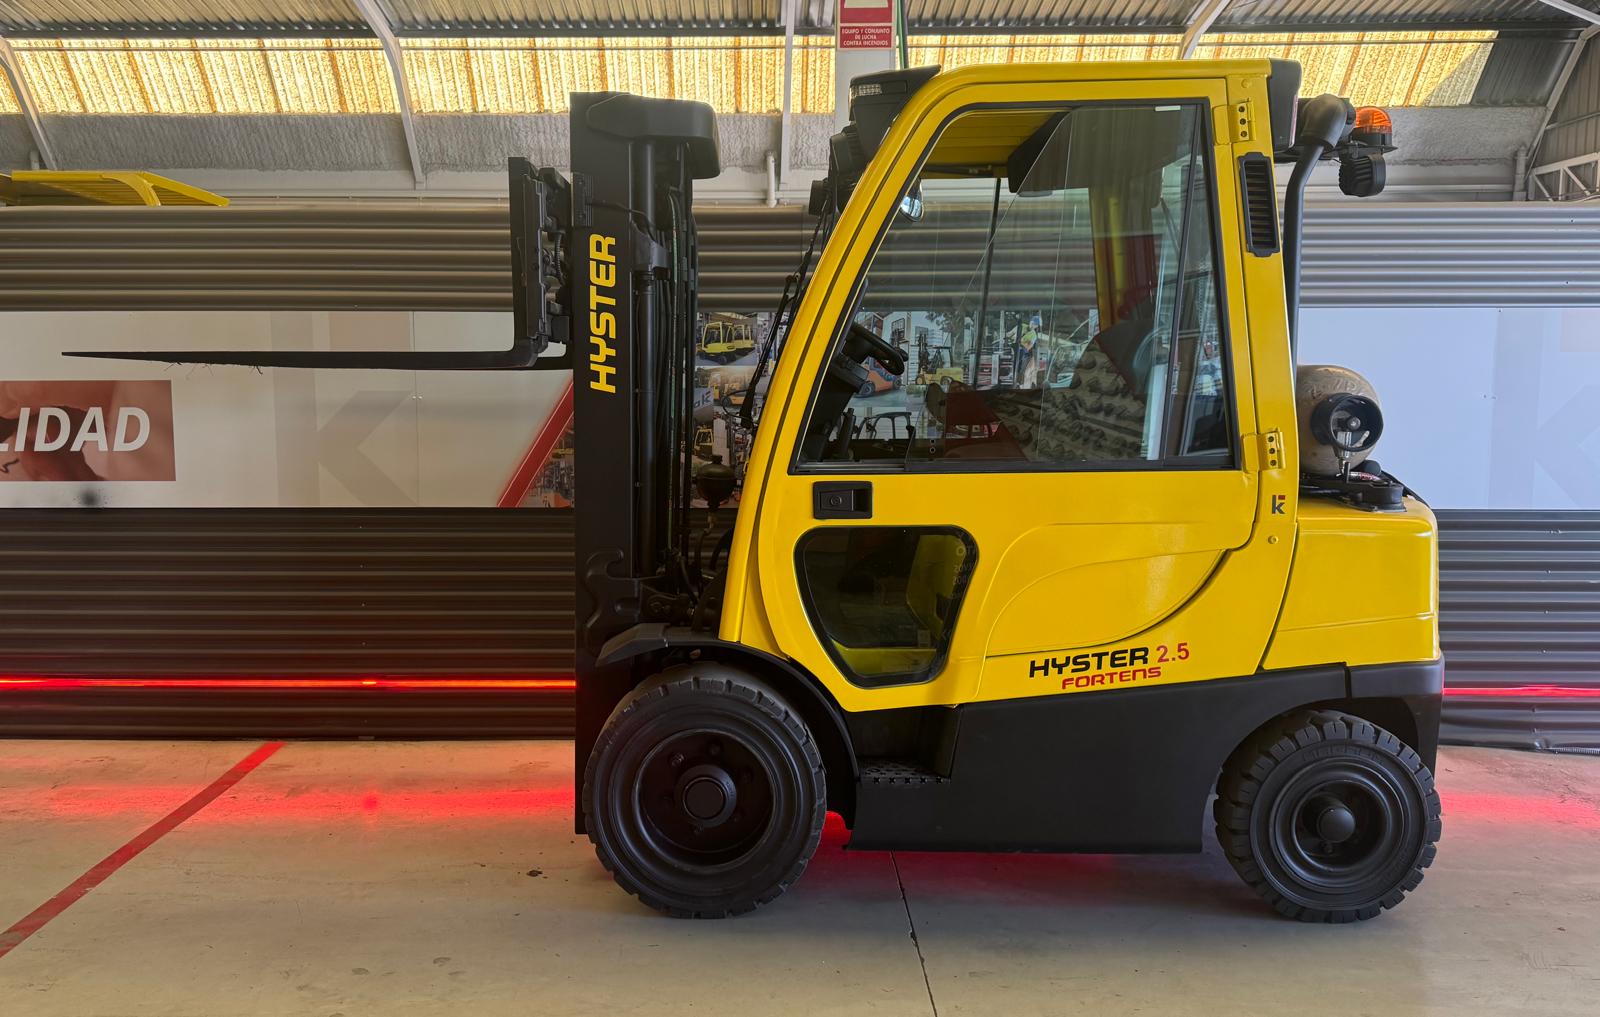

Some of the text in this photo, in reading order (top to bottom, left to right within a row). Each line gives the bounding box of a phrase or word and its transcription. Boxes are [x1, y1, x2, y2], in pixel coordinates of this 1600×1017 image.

[589, 233, 617, 394] HYSTER
[1029, 642, 1190, 678] HYSTER 2.5
[1061, 666, 1162, 690] FORTENS
